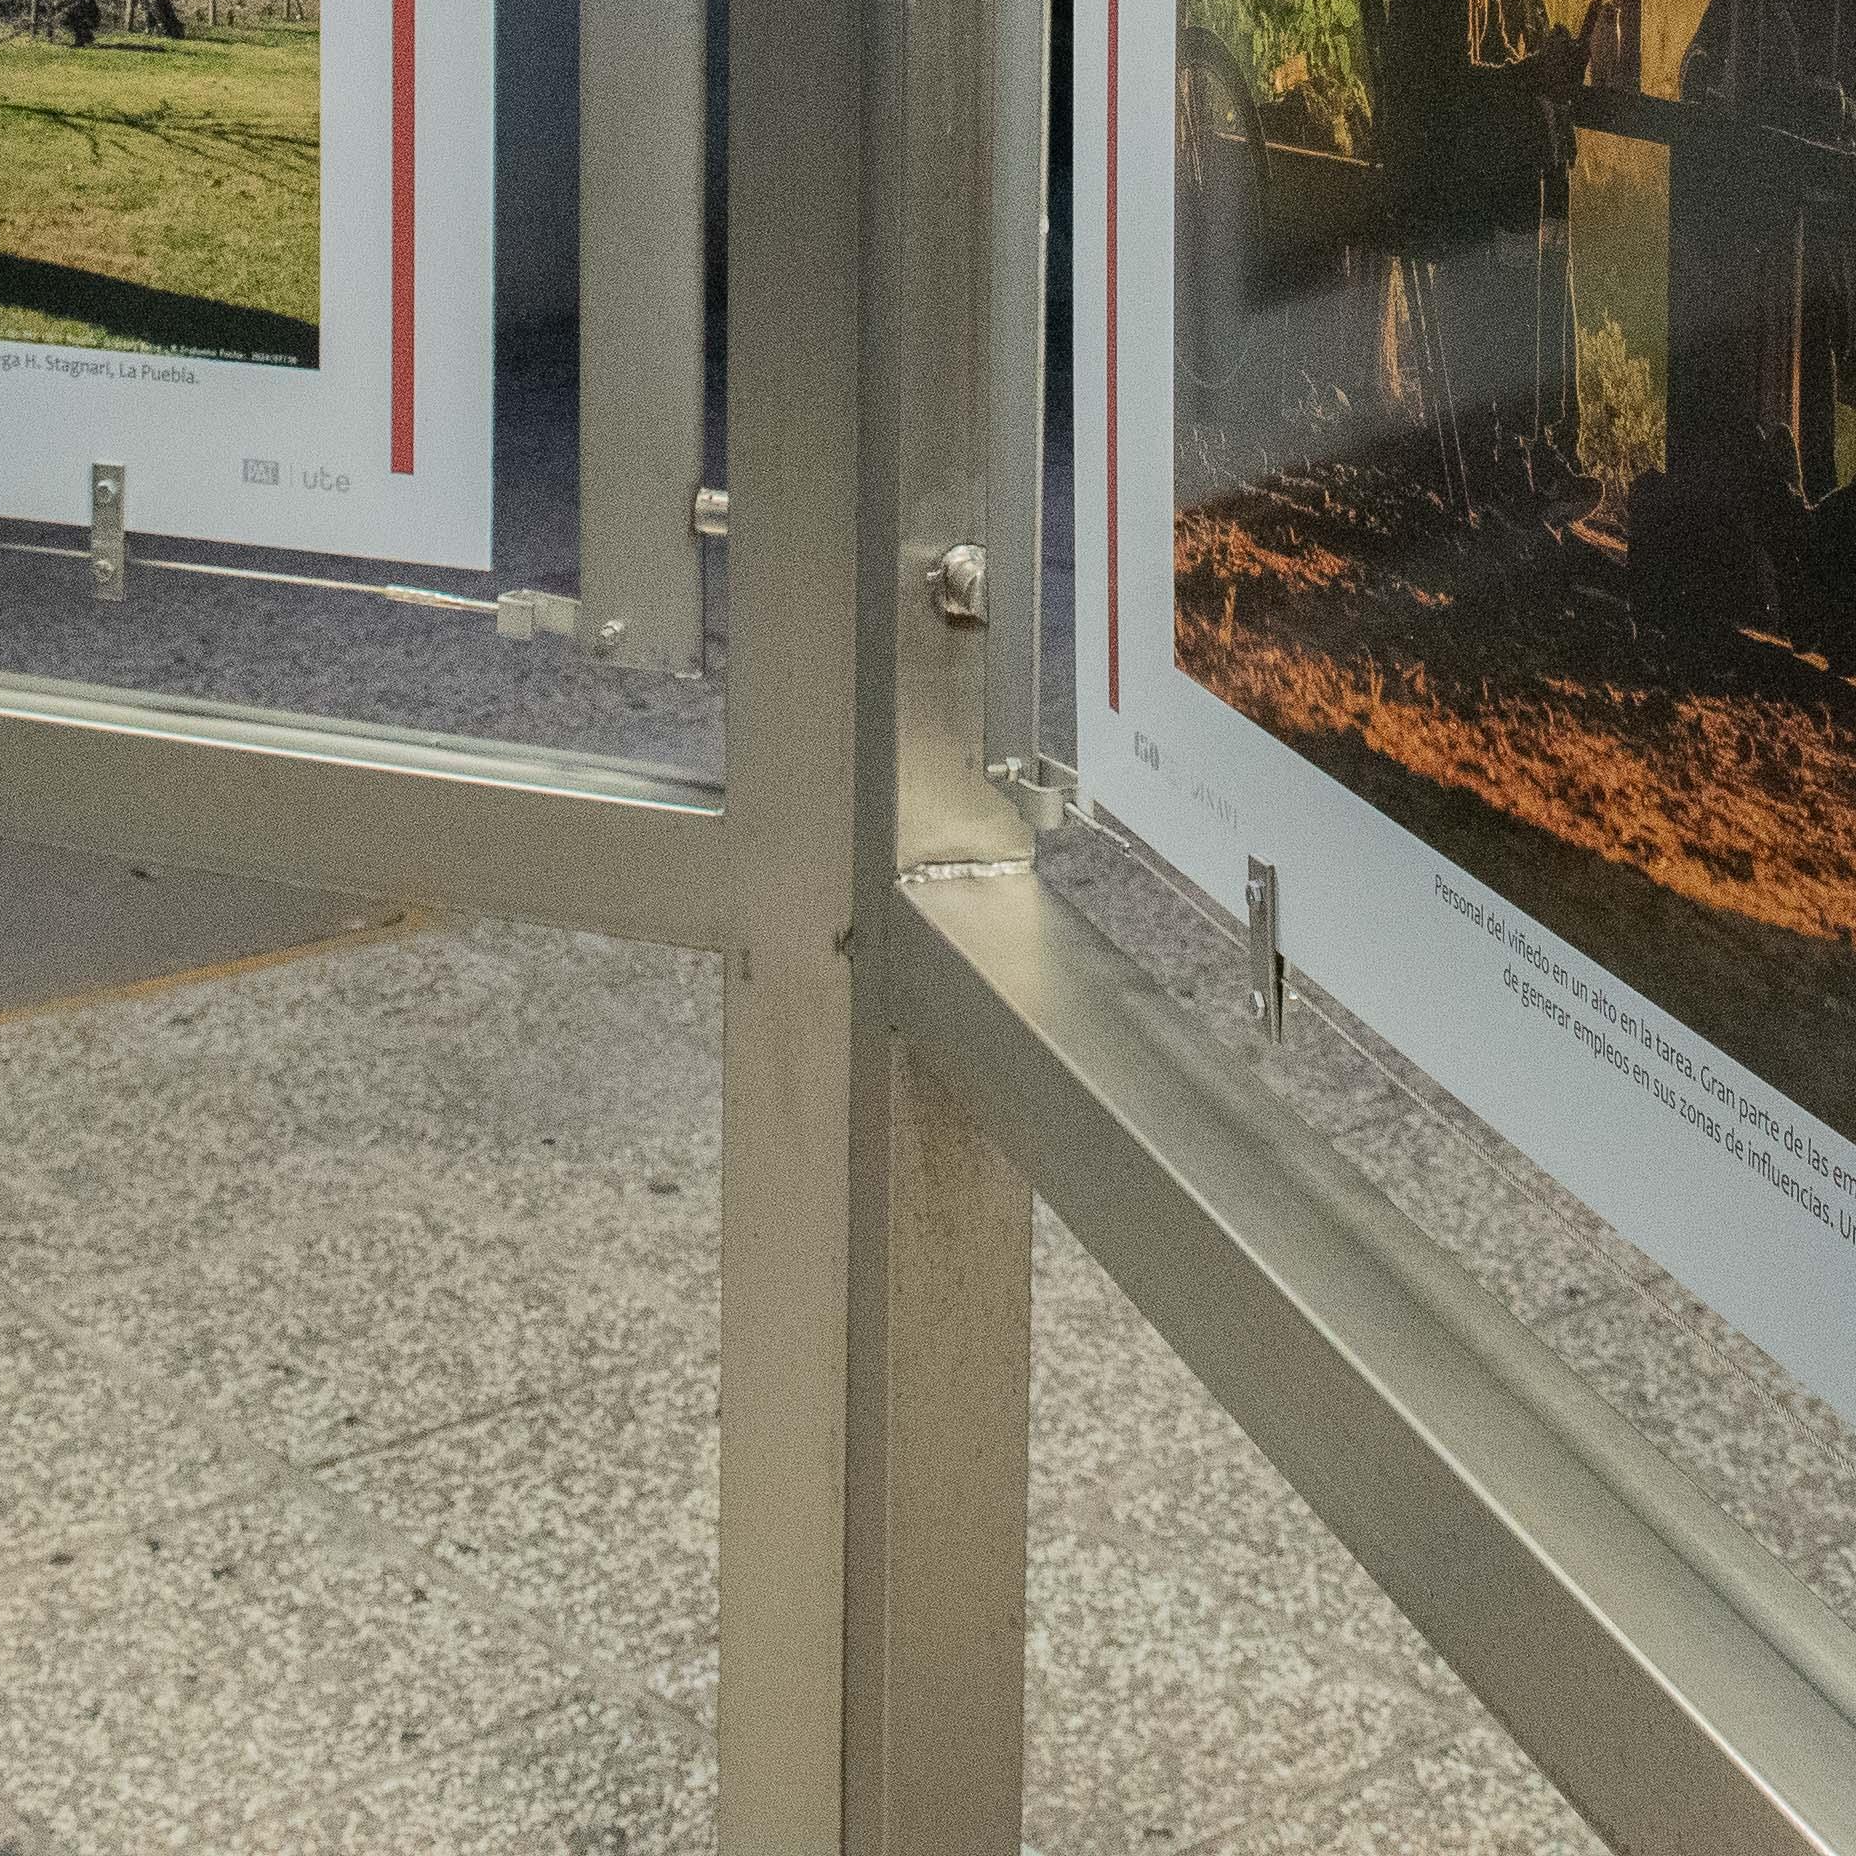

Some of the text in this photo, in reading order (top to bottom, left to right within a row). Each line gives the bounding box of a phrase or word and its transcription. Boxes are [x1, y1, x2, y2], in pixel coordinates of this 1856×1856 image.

[25, 351, 41, 370] H.
[118, 362, 137, 380] La
[142, 363, 200, 386] Puebla.
[302, 465, 351, 493] ute
[1435, 874, 1485, 928] Personal
[1487, 912, 1506, 944] del
[1508, 929, 1550, 975] viñedo
[1553, 964, 1568, 988] en
[1572, 977, 1588, 1003] un
[1591, 988, 1617, 1024] alto
[1621, 1012, 1637, 1037] en
[1641, 1017, 1653, 1050] la
[1656, 1035, 1697, 1082] tarea.
[1700, 1065, 1736, 1109] Gran
[1739, 1093, 1780, 1142] parte
[1784, 1125, 1804, 1160] de
[1808, 1138, 1829, 1177] las
[1503, 964, 1519, 992] de
[1521, 980, 1571, 1030] generar
[1574, 1019, 1630, 1075] empleos
[1633, 1063, 1650, 1091] en
[1653, 1077, 1676, 1110] sus
[1680, 1096, 1721, 1143] zonas
[1726, 1129, 1744, 1161] de
[1748, 1141, 1834, 1228] influencias.
